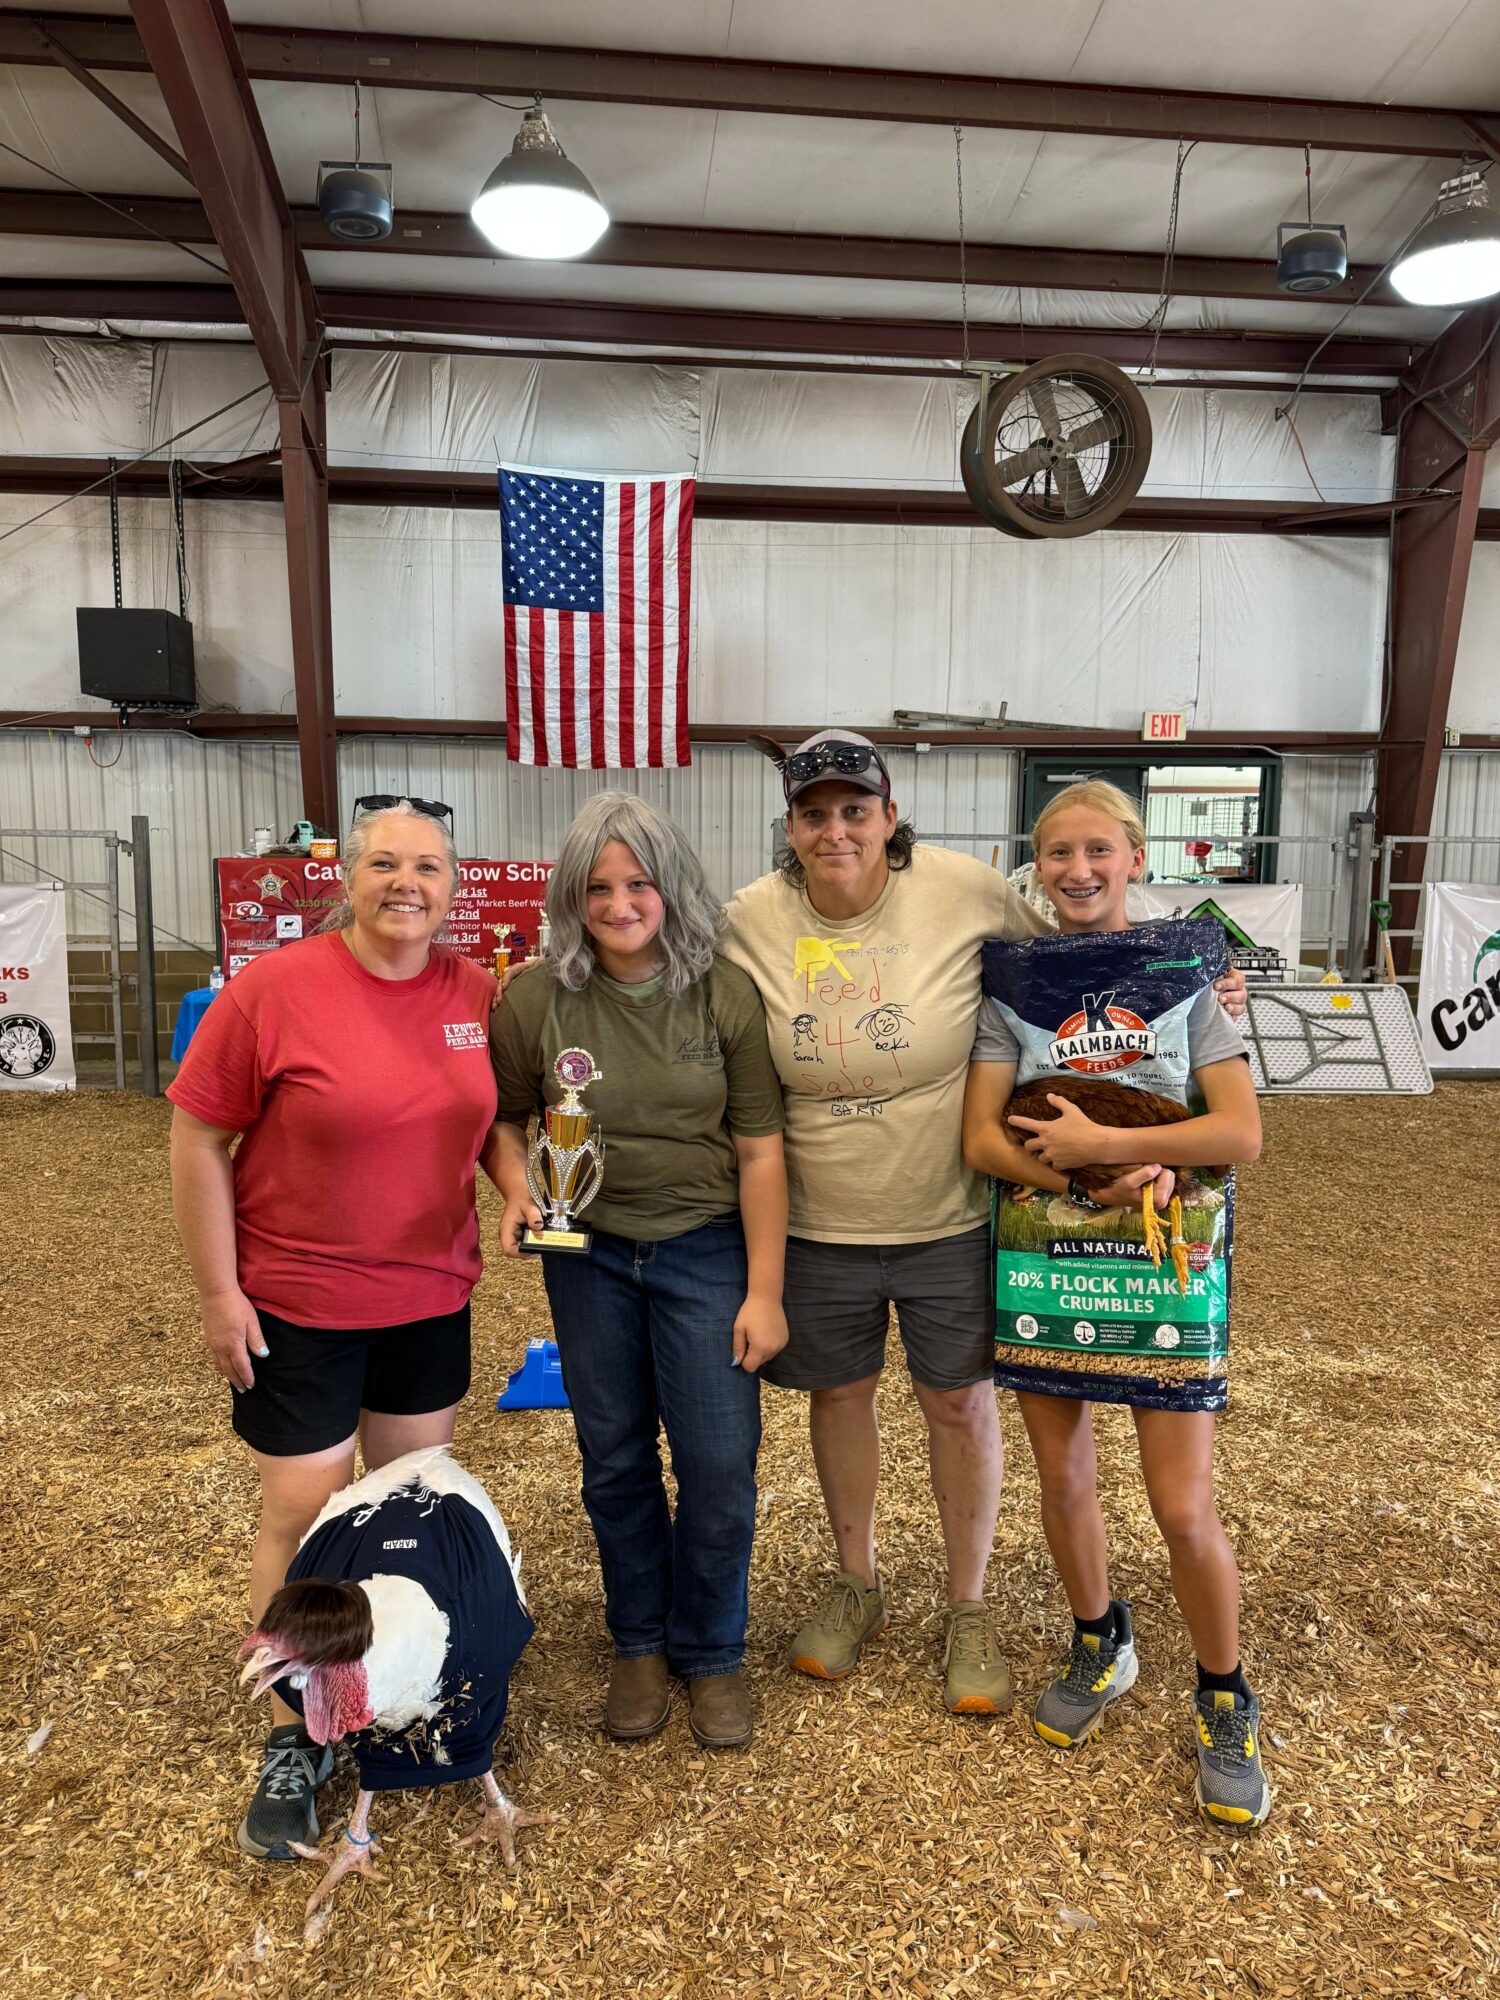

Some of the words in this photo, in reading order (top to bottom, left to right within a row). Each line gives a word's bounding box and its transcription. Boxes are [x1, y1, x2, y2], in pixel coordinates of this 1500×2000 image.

[1151, 714, 1181, 737] EXIT
[304, 862, 342, 880] Cat
[456, 862, 500, 881] how
[455, 888, 468, 898] ug
[470, 887, 487, 897] 1st
[458, 909, 480, 919] 2nd
[461, 932, 480, 942] 3rd
[451, 945, 471, 953] rrive
[0, 967, 30, 980] KS
[806, 958, 880, 1005] Feed
[1111, 1012, 1135, 1026] OWNED
[442, 1022, 484, 1038] KENT'S
[446, 1037, 467, 1046] FEED
[468, 1035, 488, 1044] BARN
[825, 1016, 860, 1068] 4
[1056, 1034, 1149, 1059] KALMBACH
[793, 1046, 824, 1064] Sarah
[1158, 1051, 1178, 1060] 1963
[1086, 1058, 1125, 1072] FEEDS
[1127, 1072, 1137, 1080] TO
[831, 1103, 882, 1117] BARN
[1053, 1242, 1079, 1253] ALL
[1083, 1242, 1153, 1256] NATURA
[1072, 1261, 1090, 1269] added
[1008, 1271, 1044, 1289] 20%
[1050, 1273, 1119, 1294] FLOCK
[1059, 1295, 1155, 1313] CRUMBLES
[383, 1539, 417, 1550] SARAH
